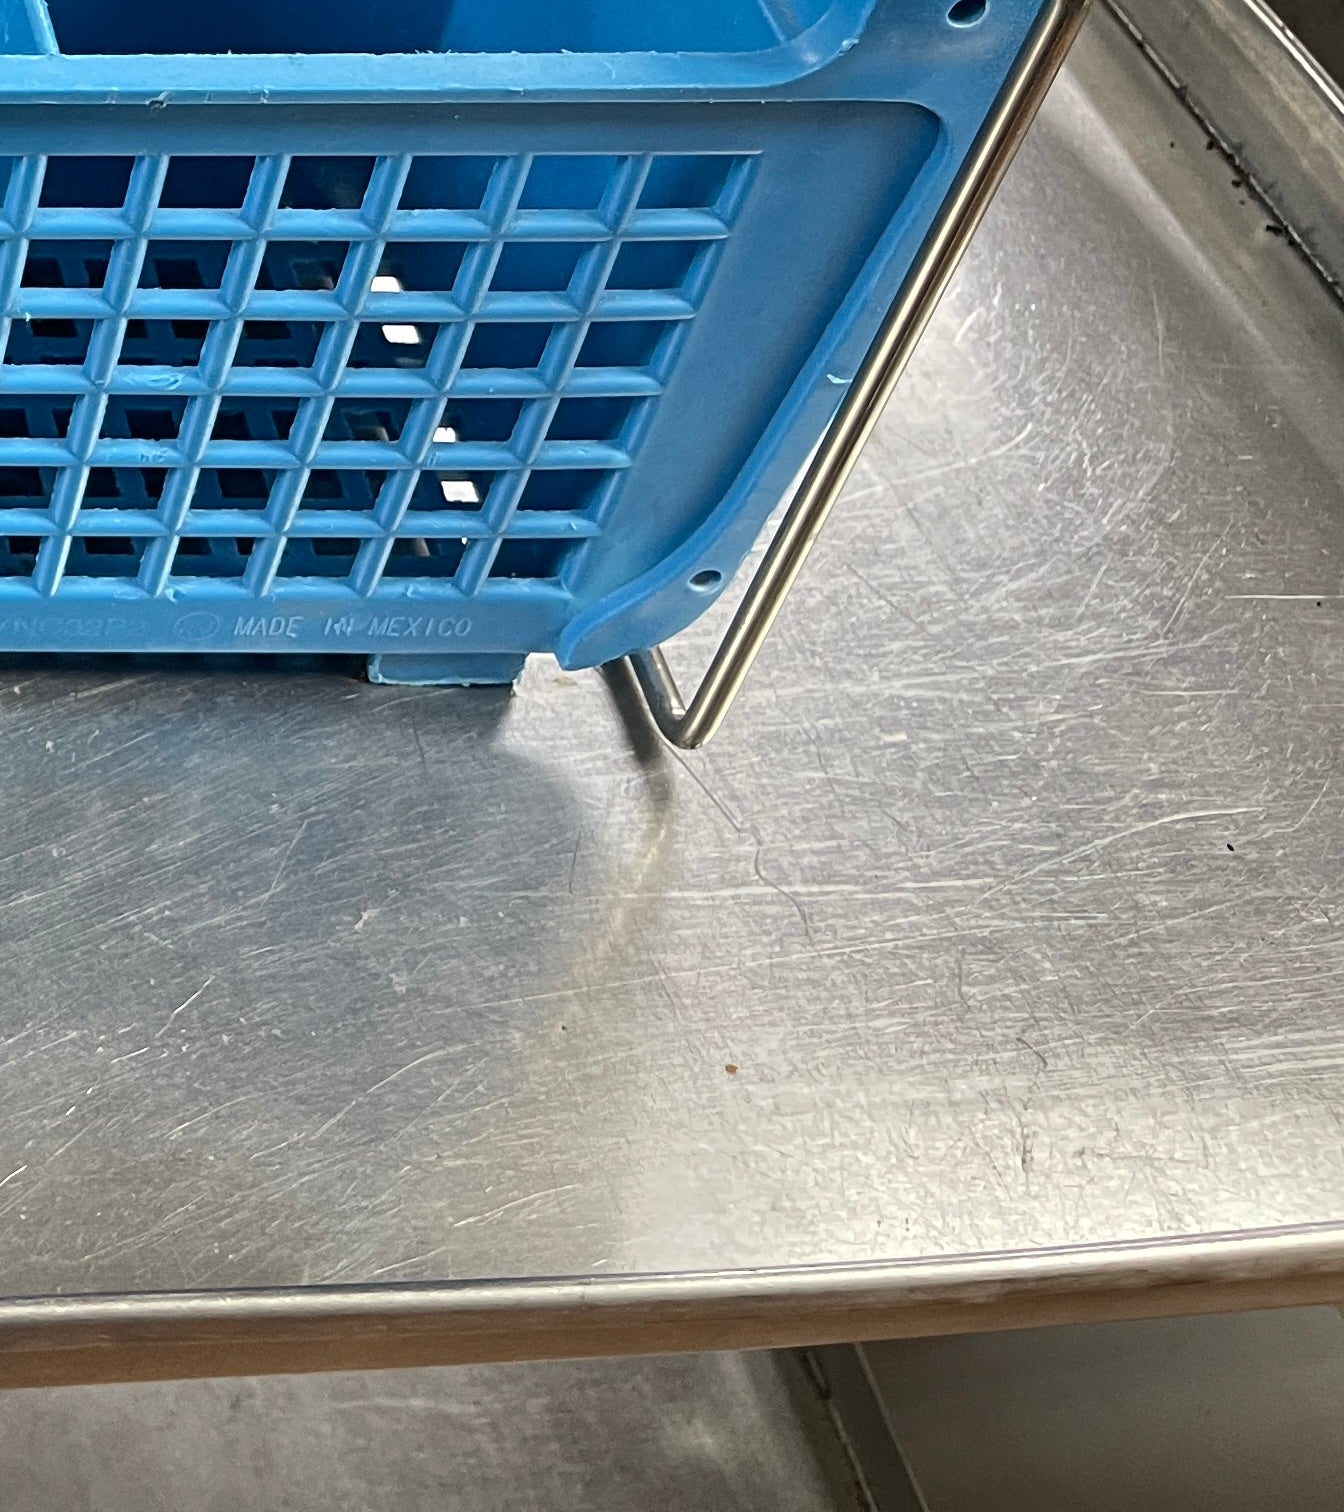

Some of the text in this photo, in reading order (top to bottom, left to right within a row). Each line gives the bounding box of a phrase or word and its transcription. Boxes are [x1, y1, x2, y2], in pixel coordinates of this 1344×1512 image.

[233, 616, 304, 638] MADE
[324, 616, 354, 637] IN
[367, 616, 473, 637] MEXICO
